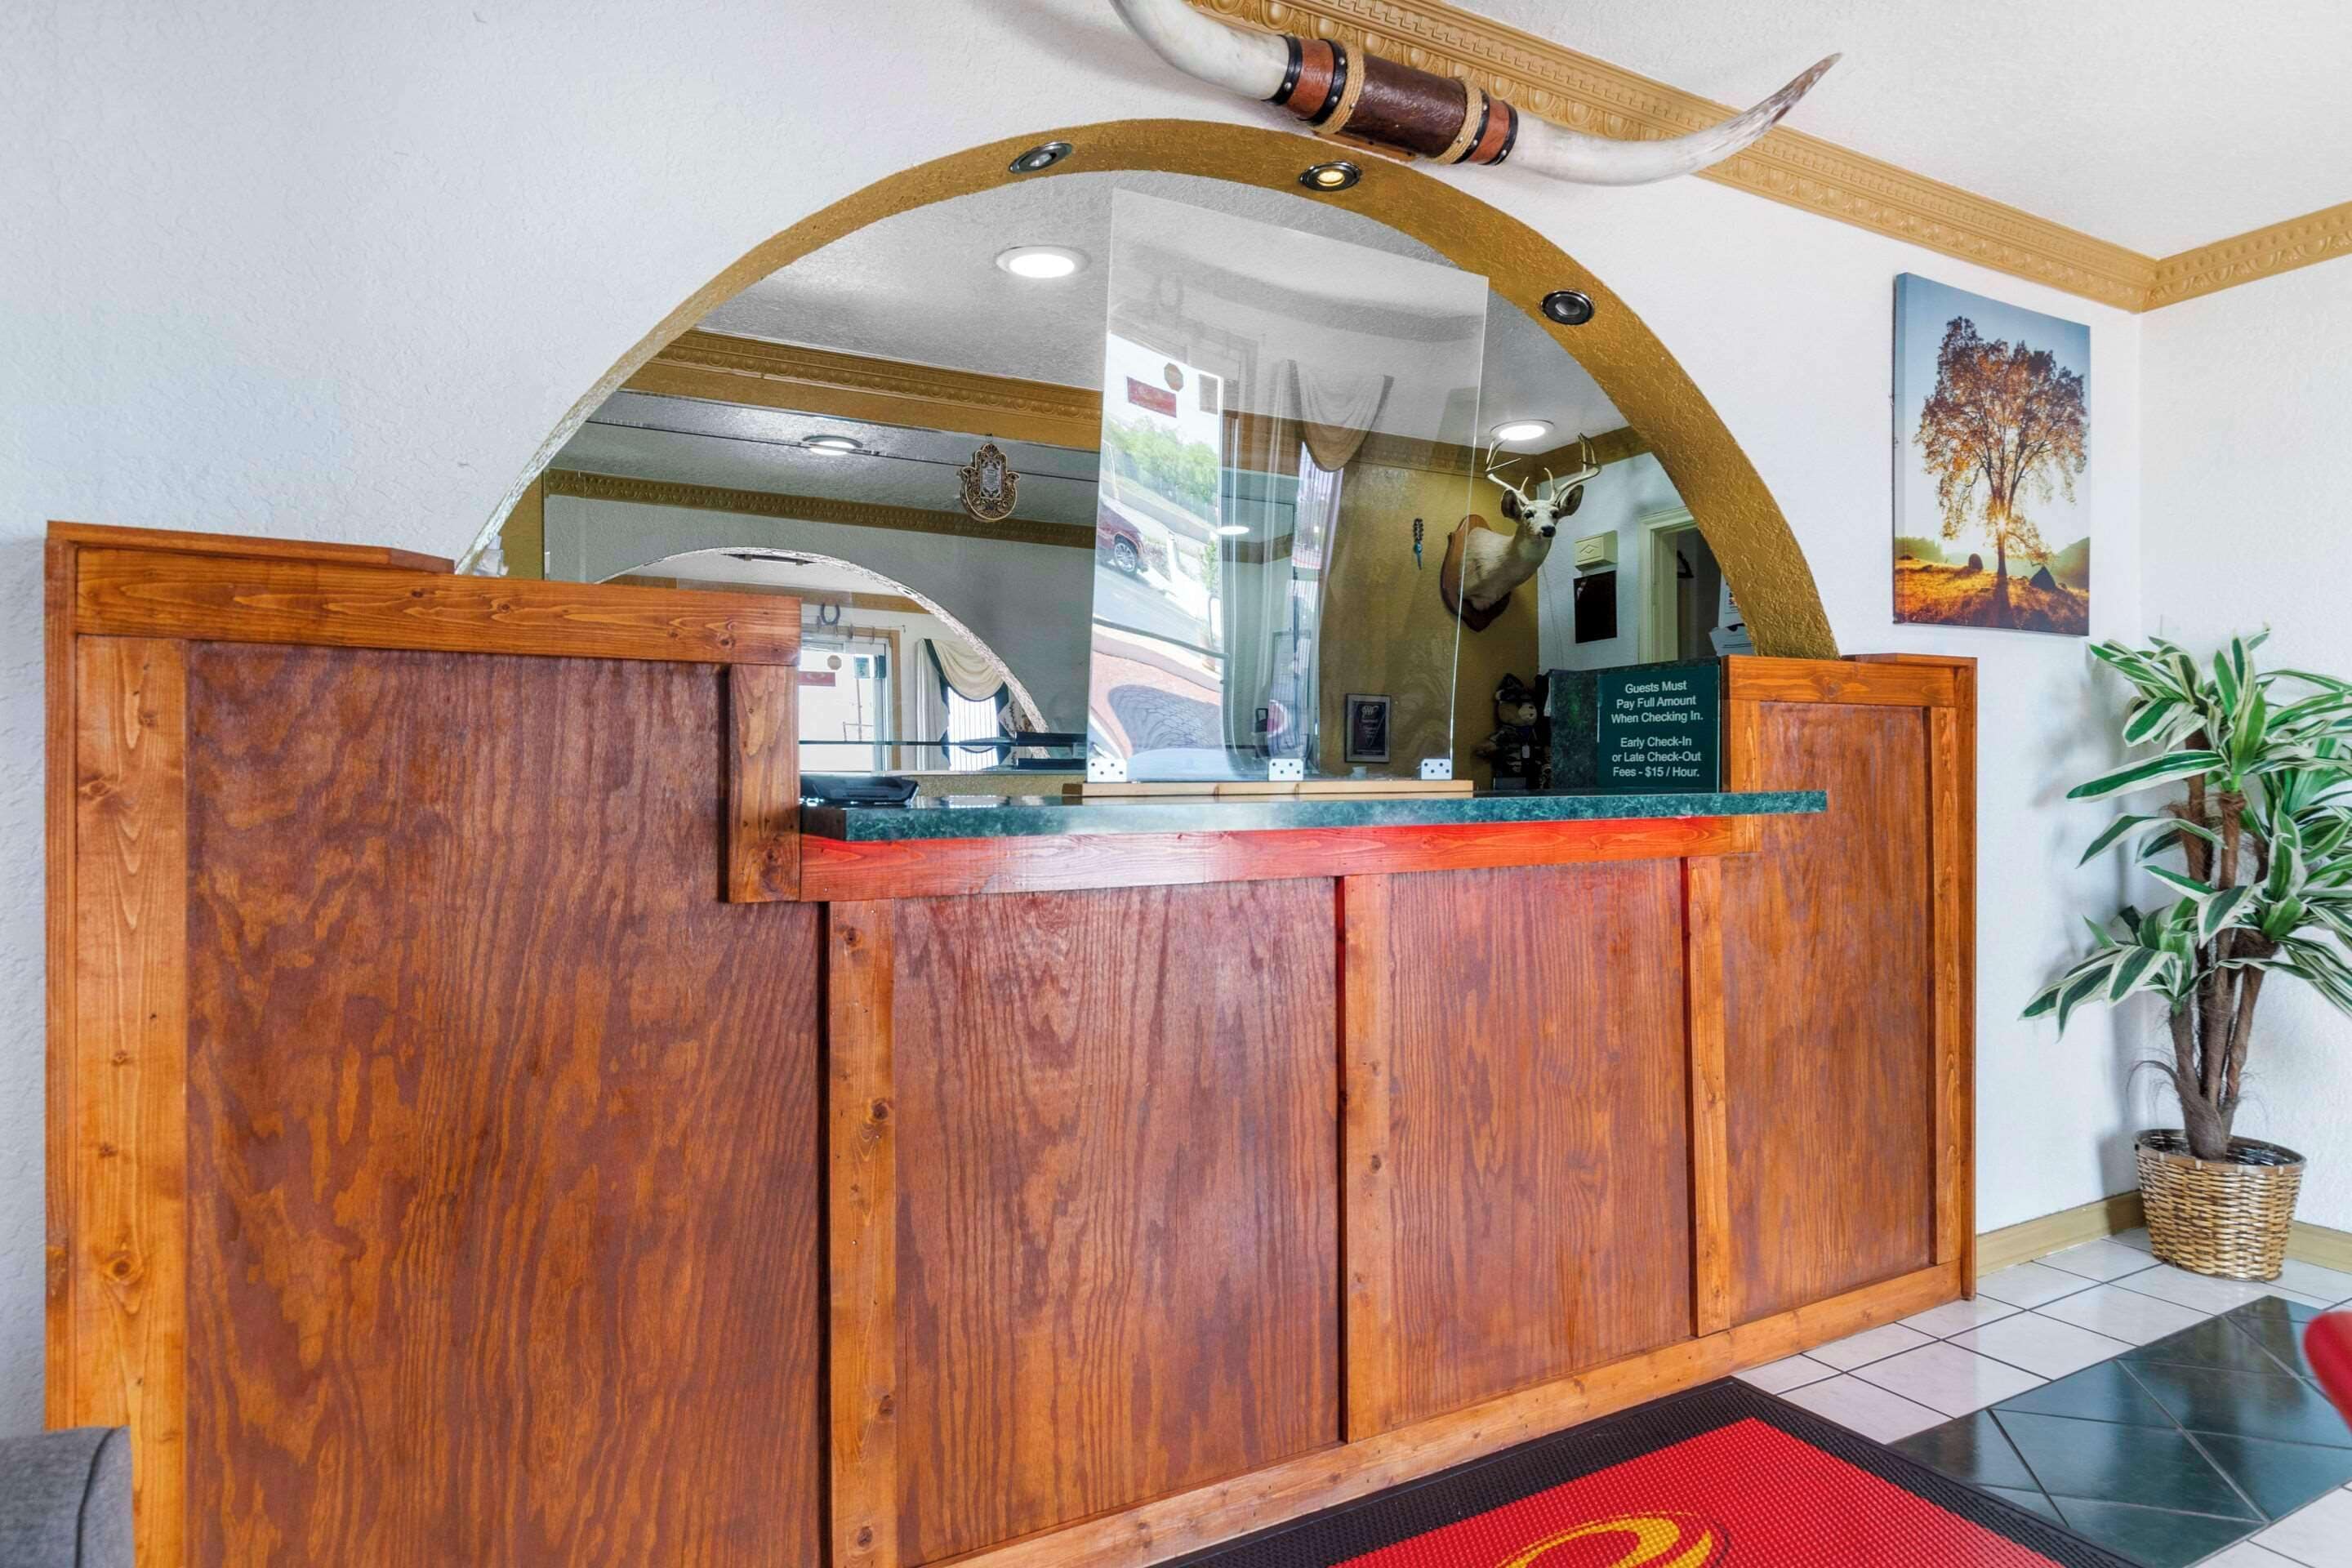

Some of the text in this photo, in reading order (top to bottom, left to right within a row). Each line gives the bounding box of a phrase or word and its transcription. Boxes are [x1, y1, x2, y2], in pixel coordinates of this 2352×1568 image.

[1625, 680, 1687, 693] Guests Must
[1616, 695, 1696, 710] Pay Full Amount
[1611, 710, 1704, 724] When Checking In.
[1620, 736, 1692, 749] Early Check-In
[1612, 751, 1701, 762] or Late Check-Out
[1613, 767, 1636, 777] Fees
[1645, 766, 1664, 777] $15
[1673, 767, 1699, 777] Hour.
